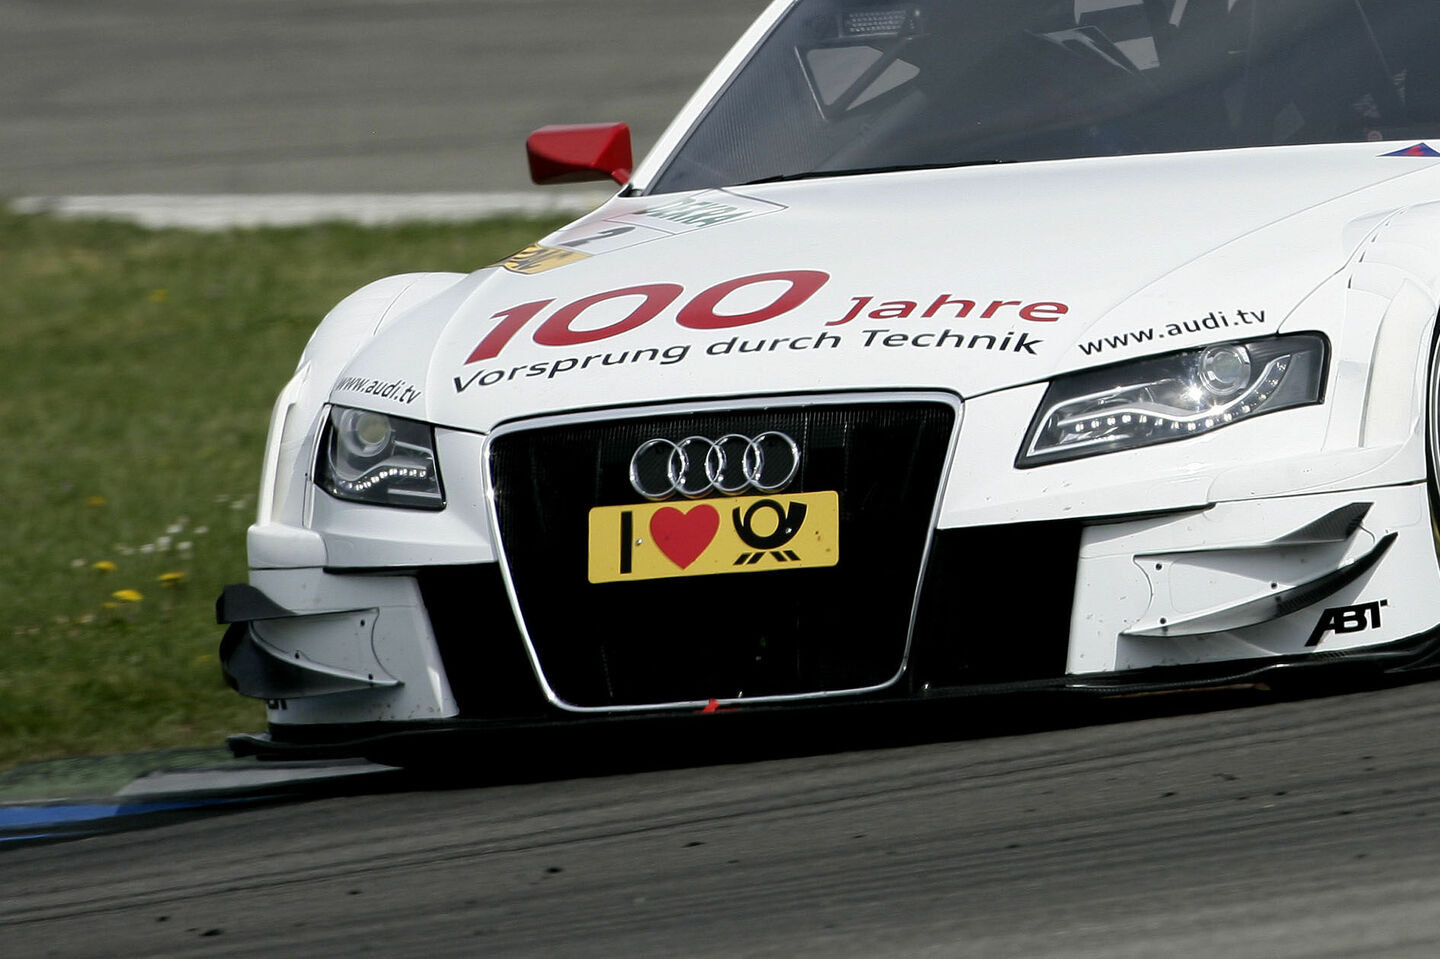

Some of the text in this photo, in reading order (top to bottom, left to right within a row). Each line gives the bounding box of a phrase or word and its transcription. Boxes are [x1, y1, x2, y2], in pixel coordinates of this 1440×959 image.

[464, 270, 1070, 366] 100 Jahre
[1077, 306, 1269, 358] www.audi.tv
[453, 329, 1046, 394] Vorsprung durch Technik
[336, 376, 422, 405] www.audi.tv
[1303, 599, 1389, 647] ABT
